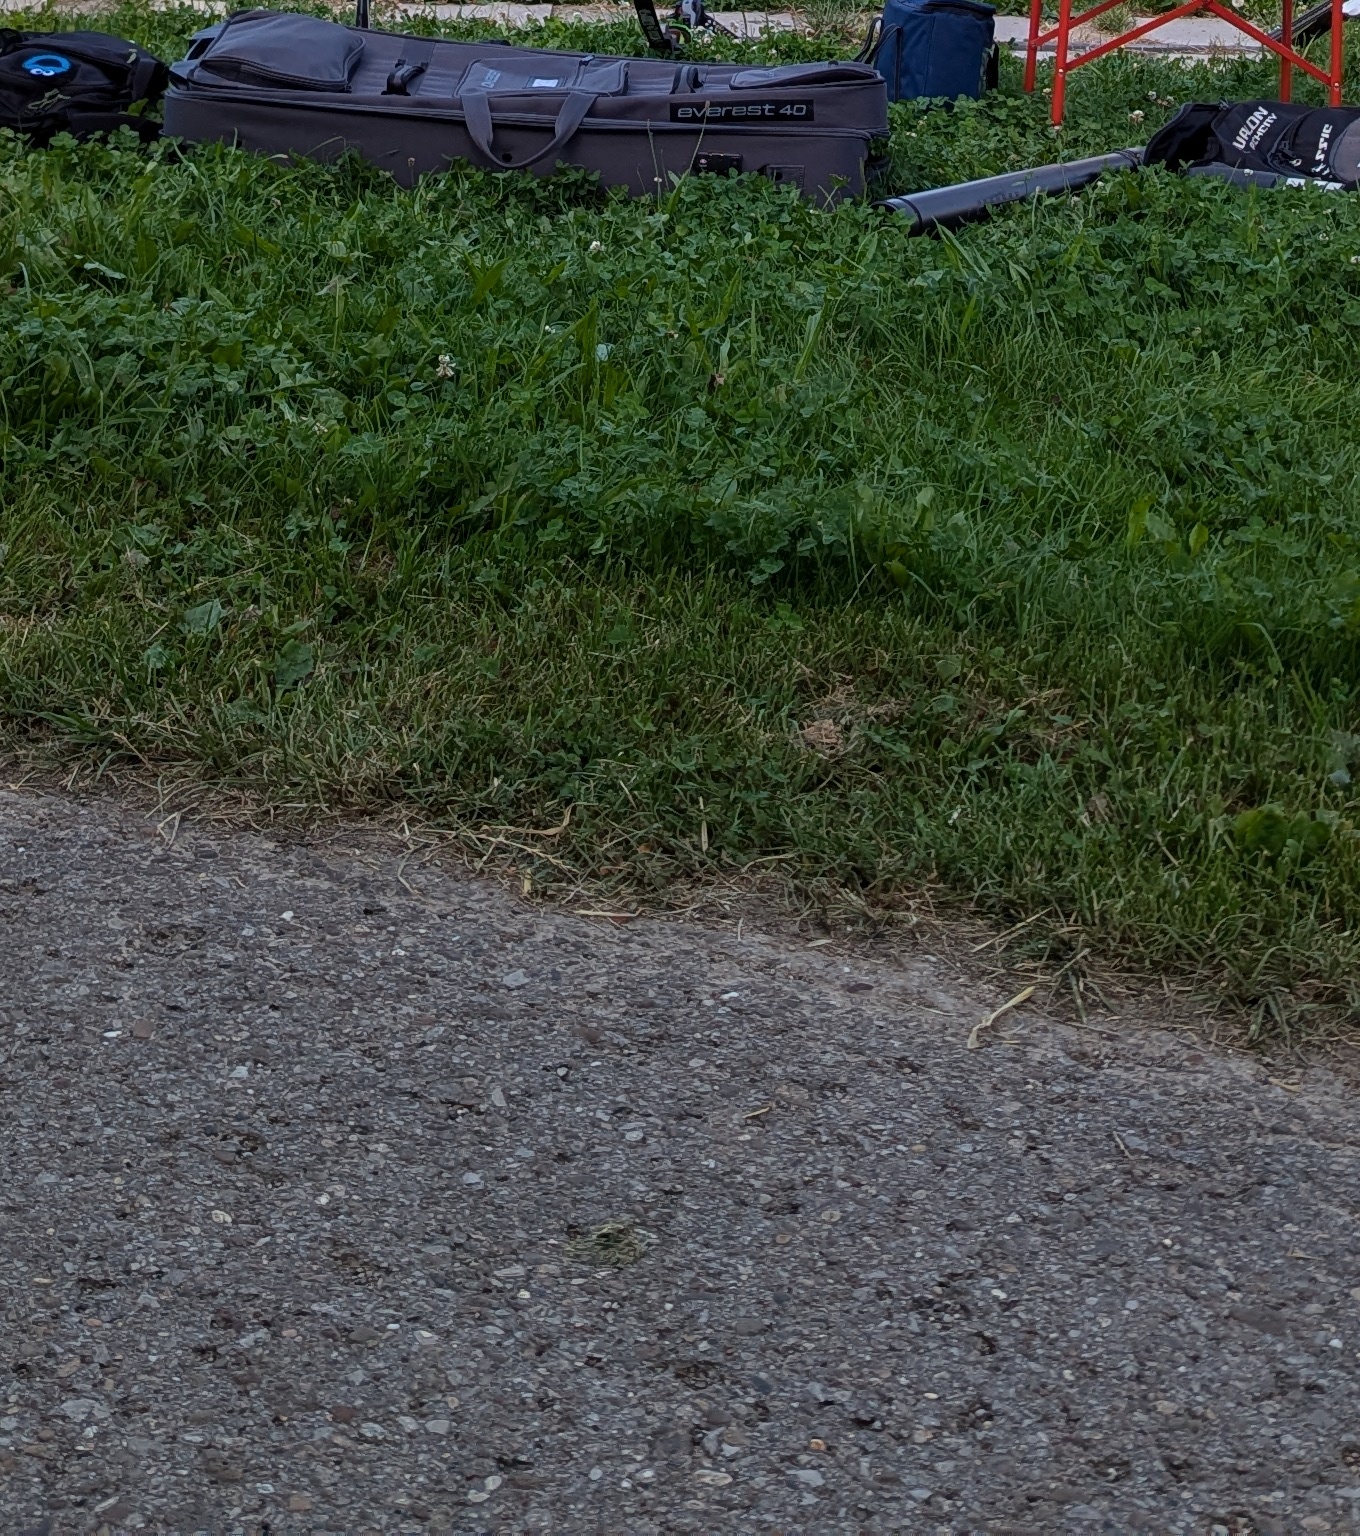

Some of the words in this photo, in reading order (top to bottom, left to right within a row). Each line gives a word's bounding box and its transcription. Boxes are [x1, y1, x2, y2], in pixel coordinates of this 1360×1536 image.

[677, 104, 776, 118] everest
[778, 104, 807, 116] 40
[1232, 105, 1269, 151] VALON
